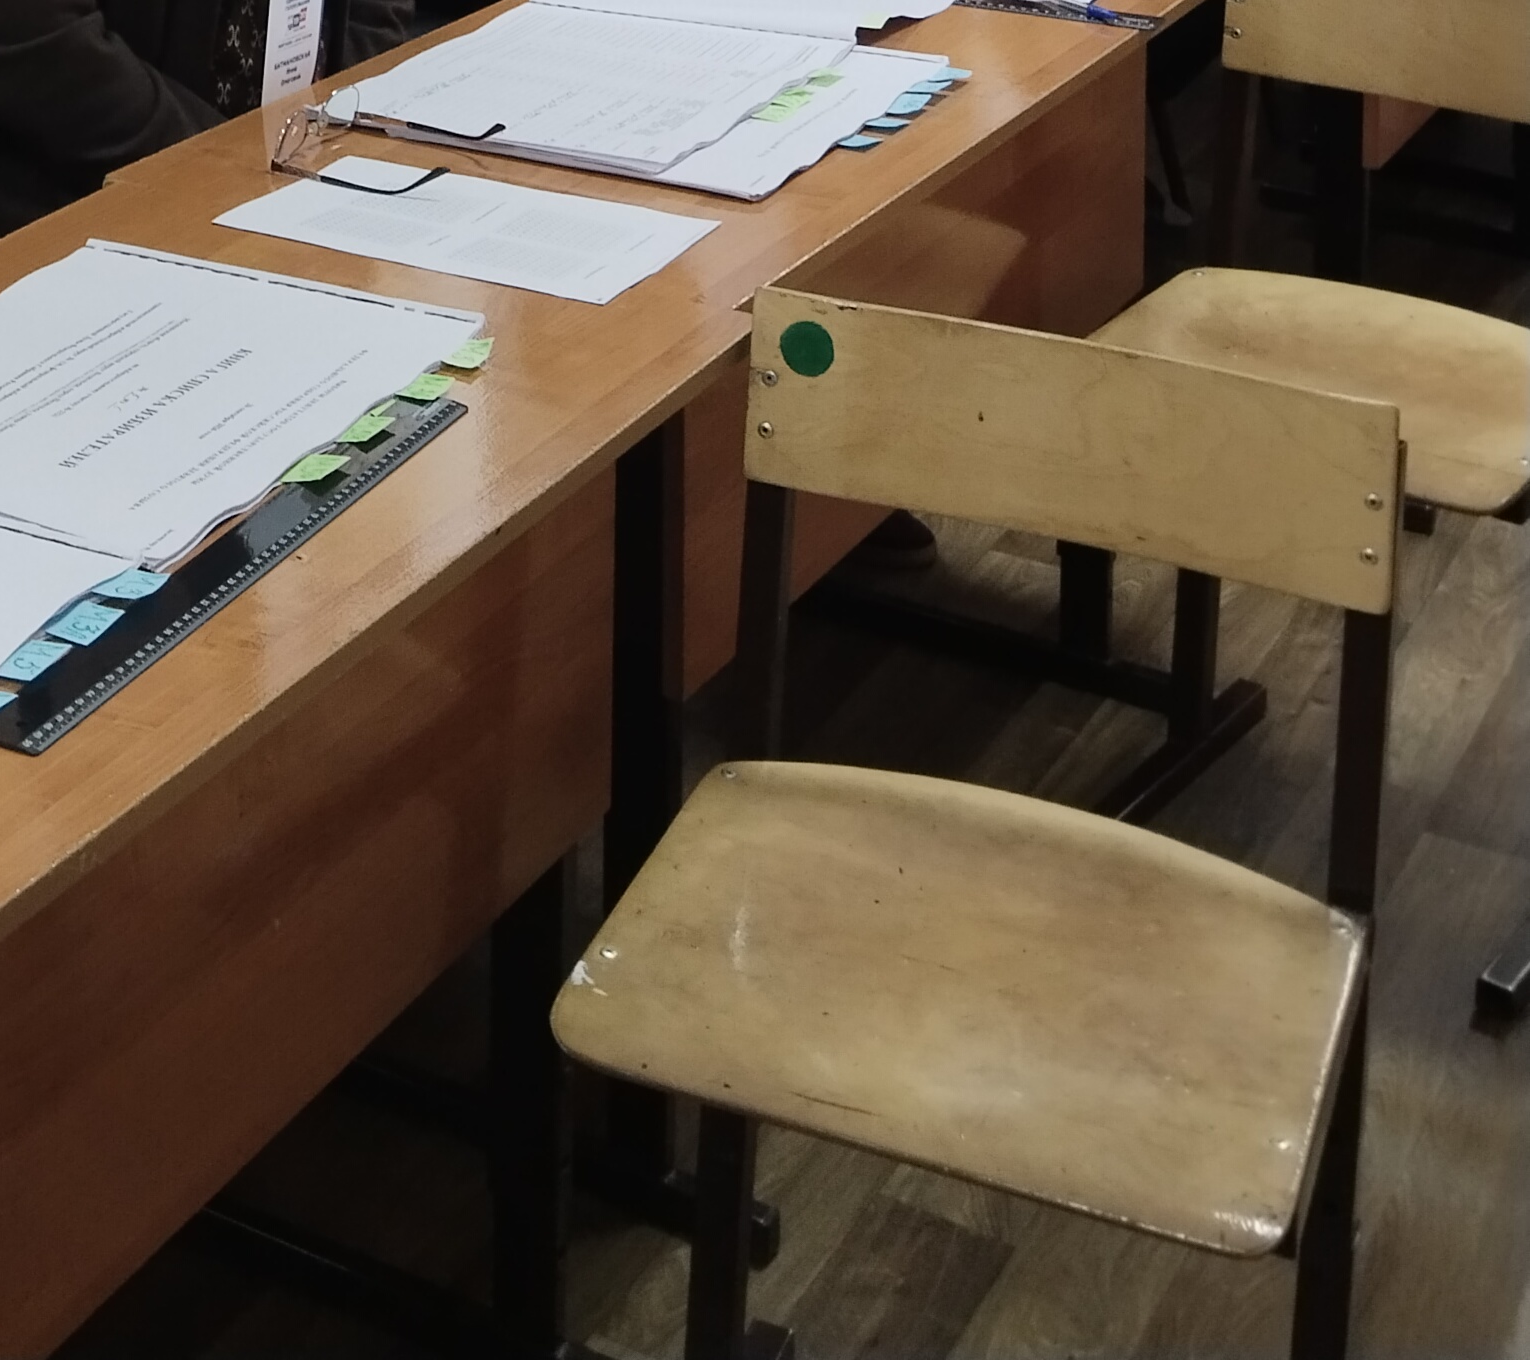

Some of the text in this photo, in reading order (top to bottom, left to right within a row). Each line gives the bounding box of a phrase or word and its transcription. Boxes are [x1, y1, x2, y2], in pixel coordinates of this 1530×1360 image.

[205, 348, 253, 374] КНИГА
[152, 374, 210, 407] СПИСКА
[58, 407, 159, 468] ИЗБИРАТЕЛЕЙ
